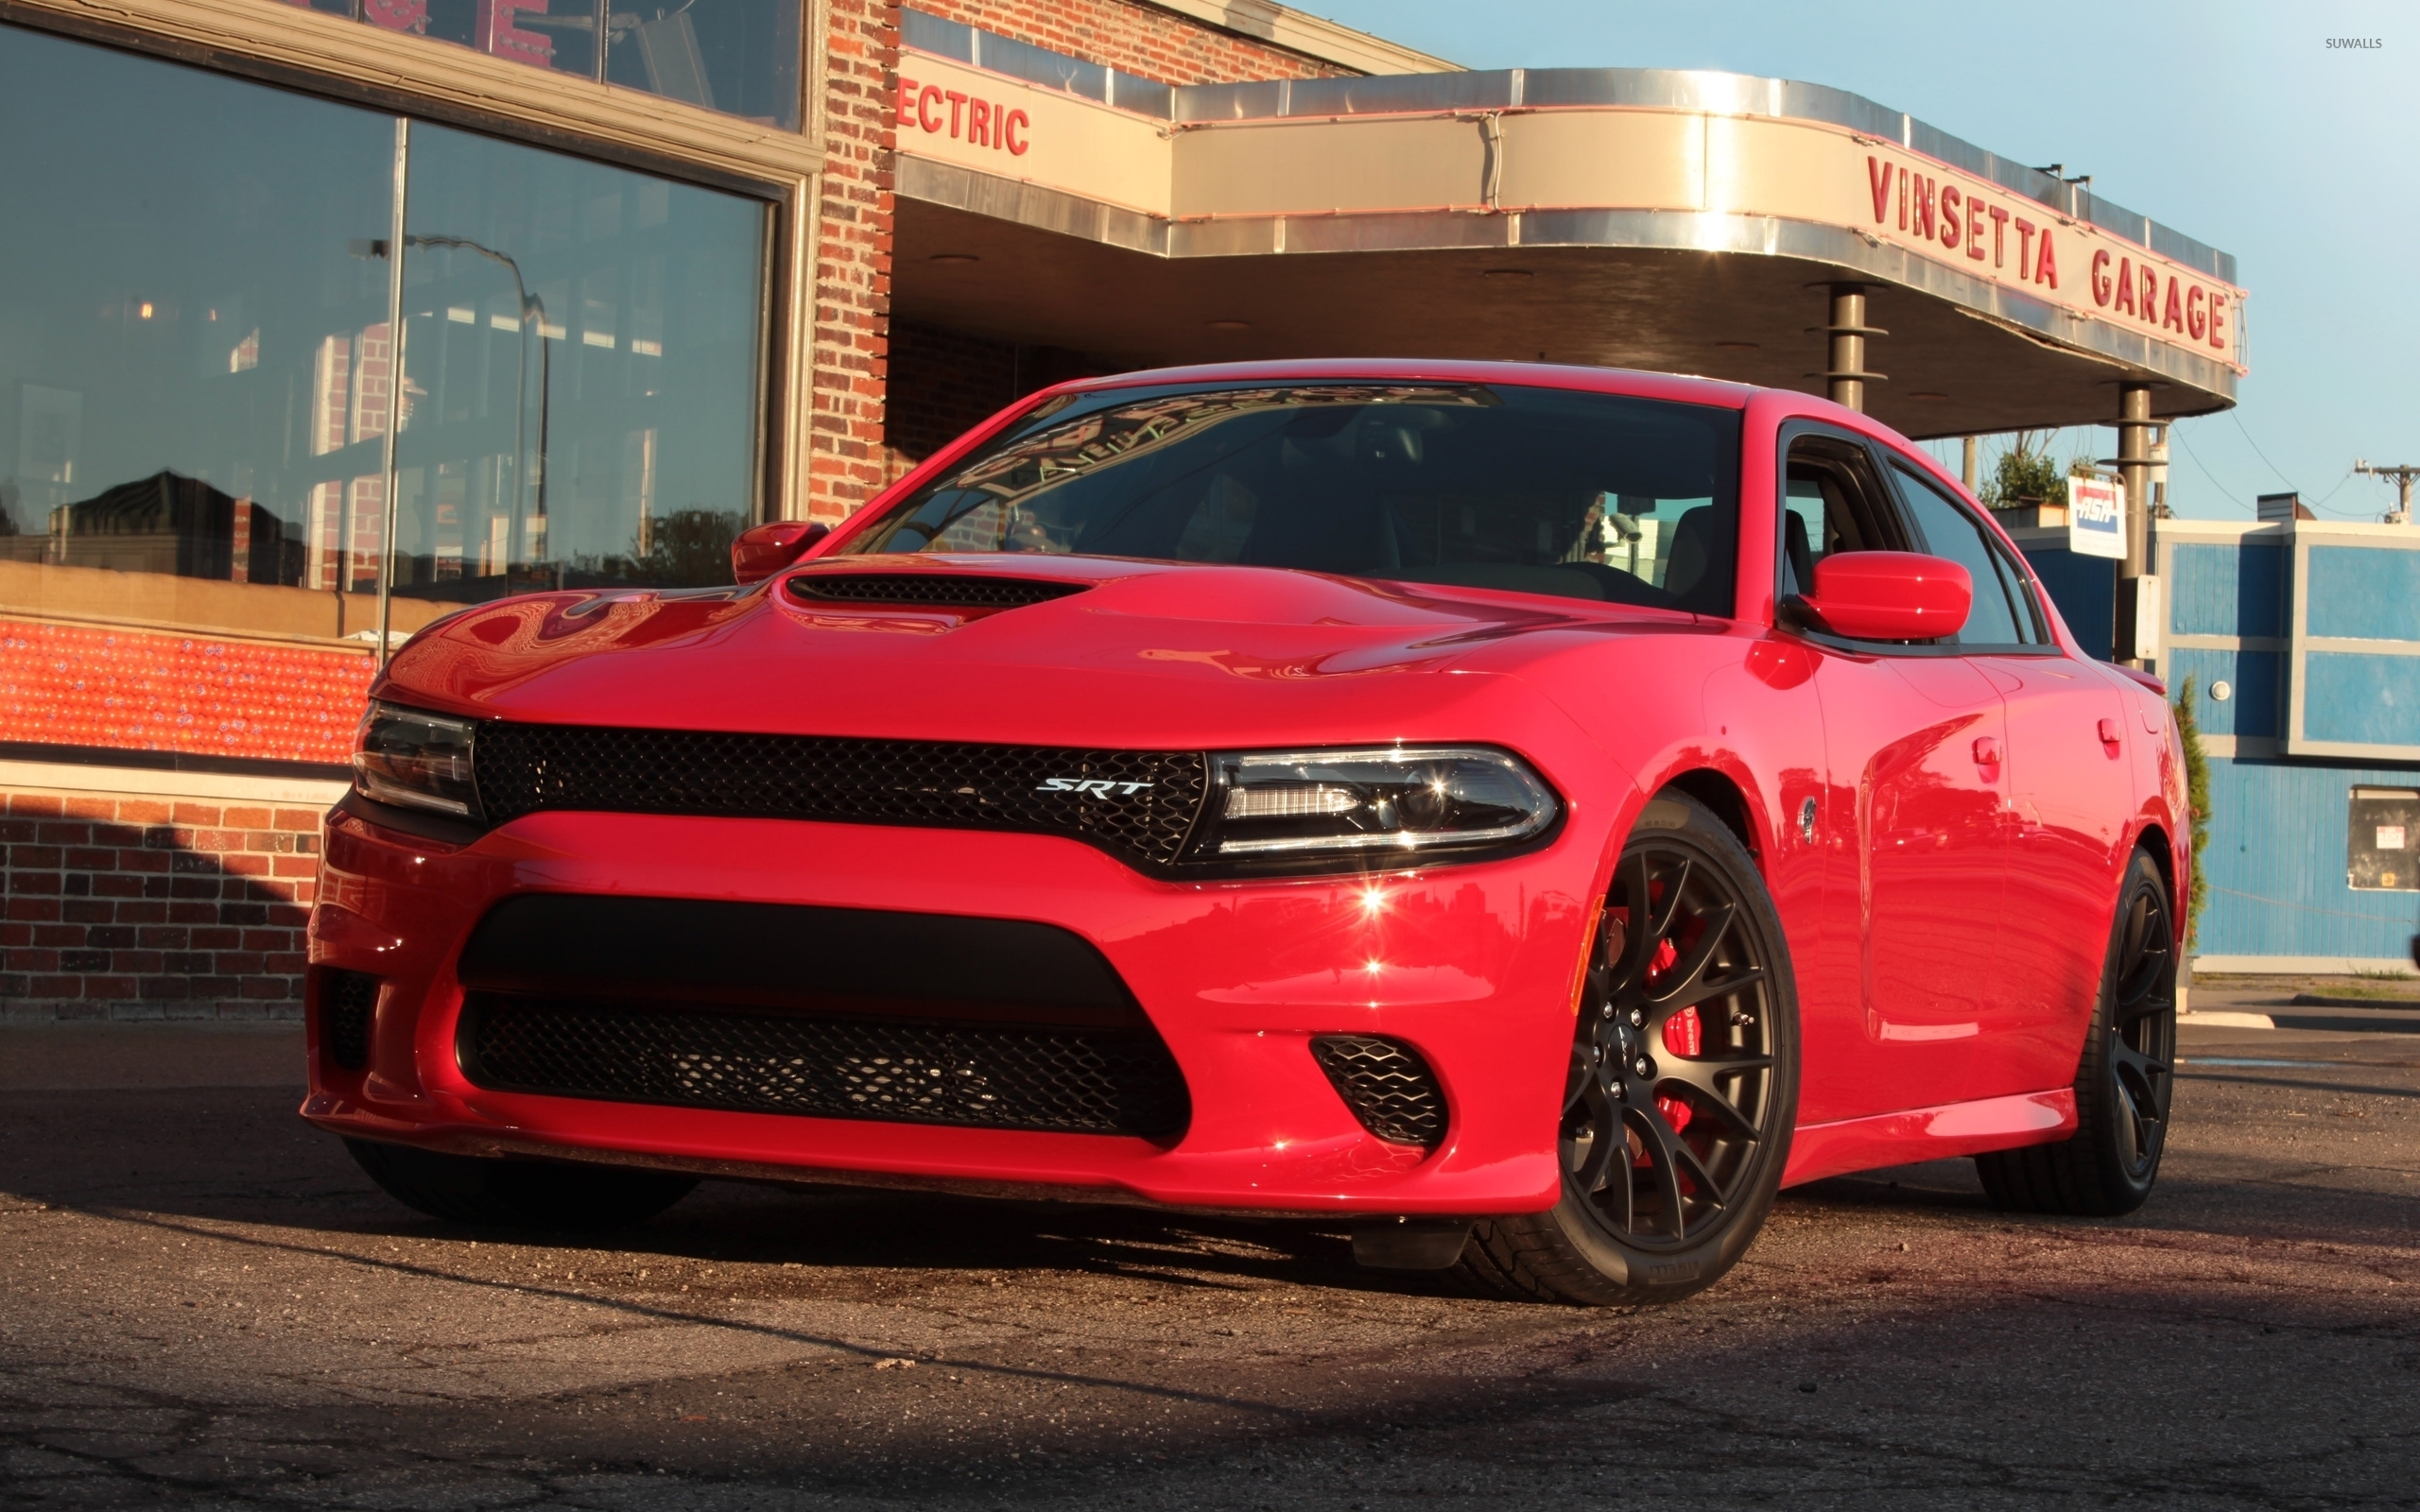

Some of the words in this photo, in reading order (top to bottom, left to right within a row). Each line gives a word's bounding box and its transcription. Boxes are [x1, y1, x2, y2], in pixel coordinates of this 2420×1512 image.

[897, 77, 1029, 156] ECTRIC
[1868, 156, 2058, 289] VINSETTA
[2092, 249, 2225, 349] GARAGE
[1036, 778, 1154, 799] SRT
